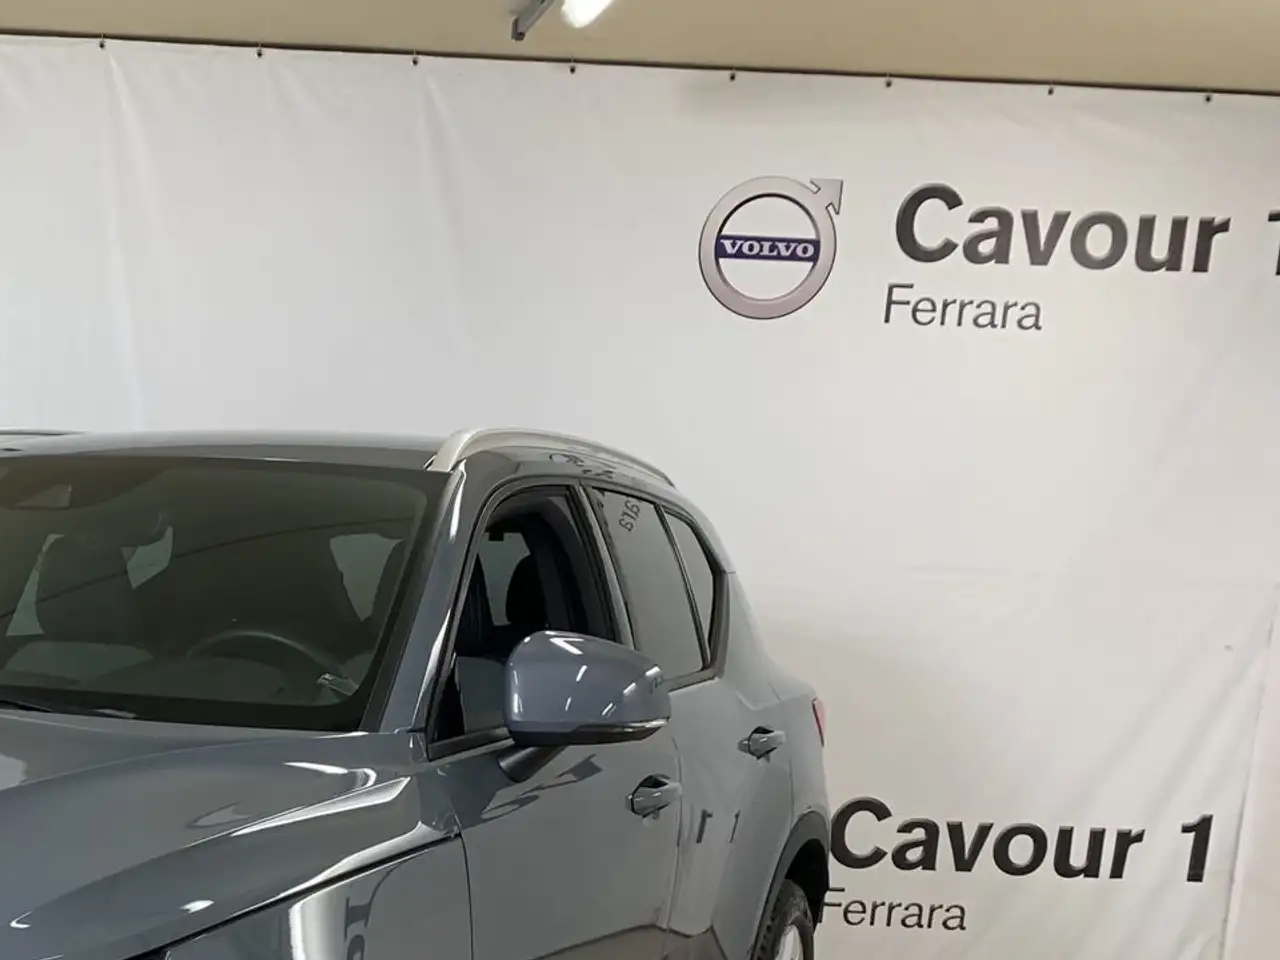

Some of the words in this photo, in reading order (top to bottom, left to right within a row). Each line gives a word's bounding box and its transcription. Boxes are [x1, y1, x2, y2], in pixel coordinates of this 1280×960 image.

[720, 239, 814, 258] VOLVO
[895, 182, 1231, 273] Cavour
[883, 282, 1042, 331] Ferrara
[830, 796, 1145, 879] Cavour
[1181, 814, 1213, 883] 1
